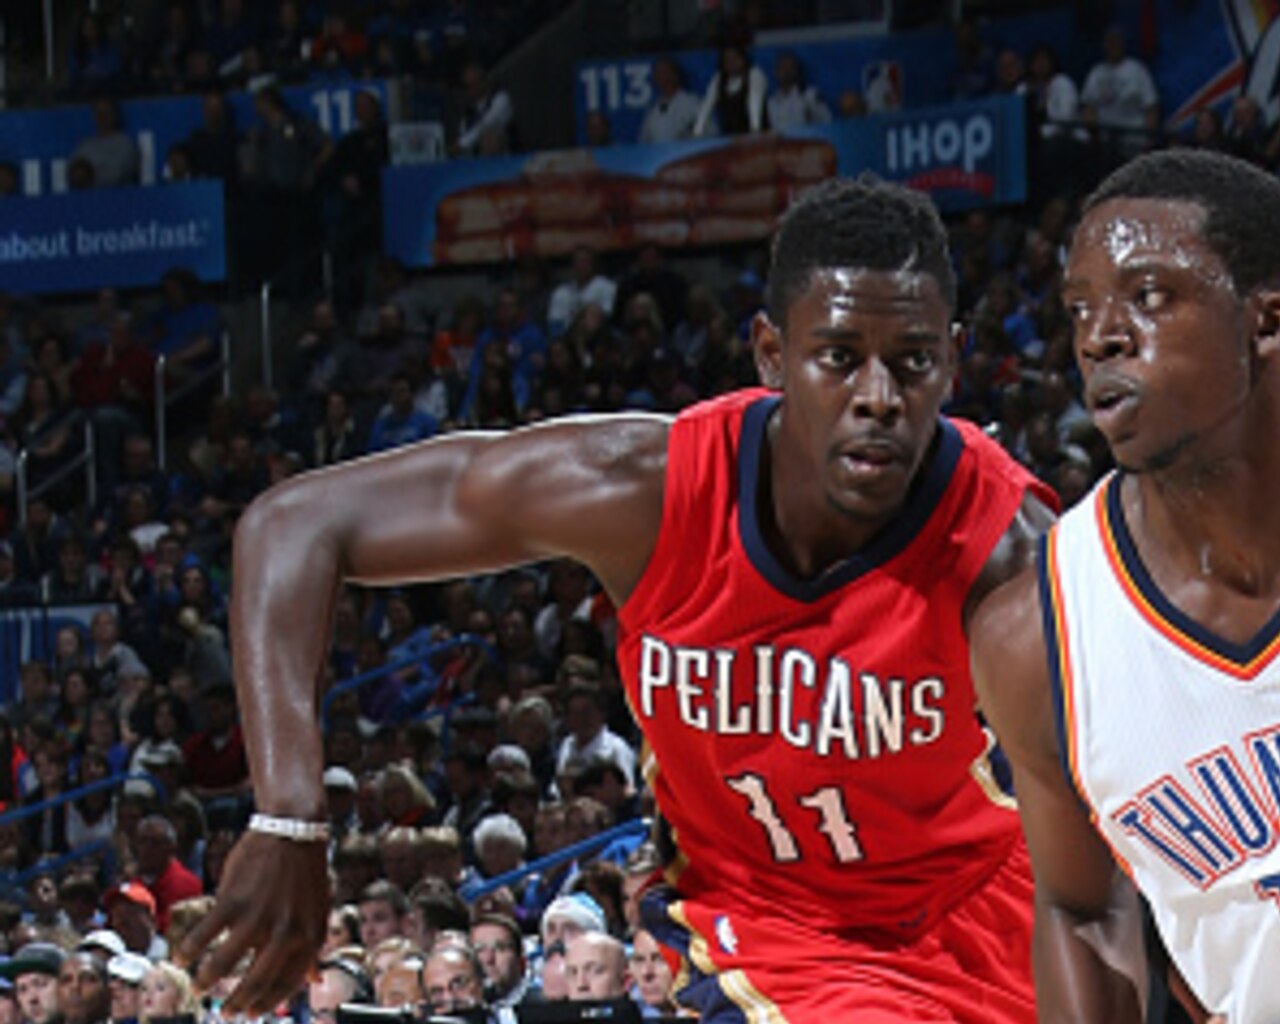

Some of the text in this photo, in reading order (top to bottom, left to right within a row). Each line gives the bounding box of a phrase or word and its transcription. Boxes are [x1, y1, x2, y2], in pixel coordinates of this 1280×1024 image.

[579, 63, 653, 112] 113
[886, 114, 993, 174] IHOP
[640, 634, 945, 760] PELICANS
[726, 771, 864, 863] 11
